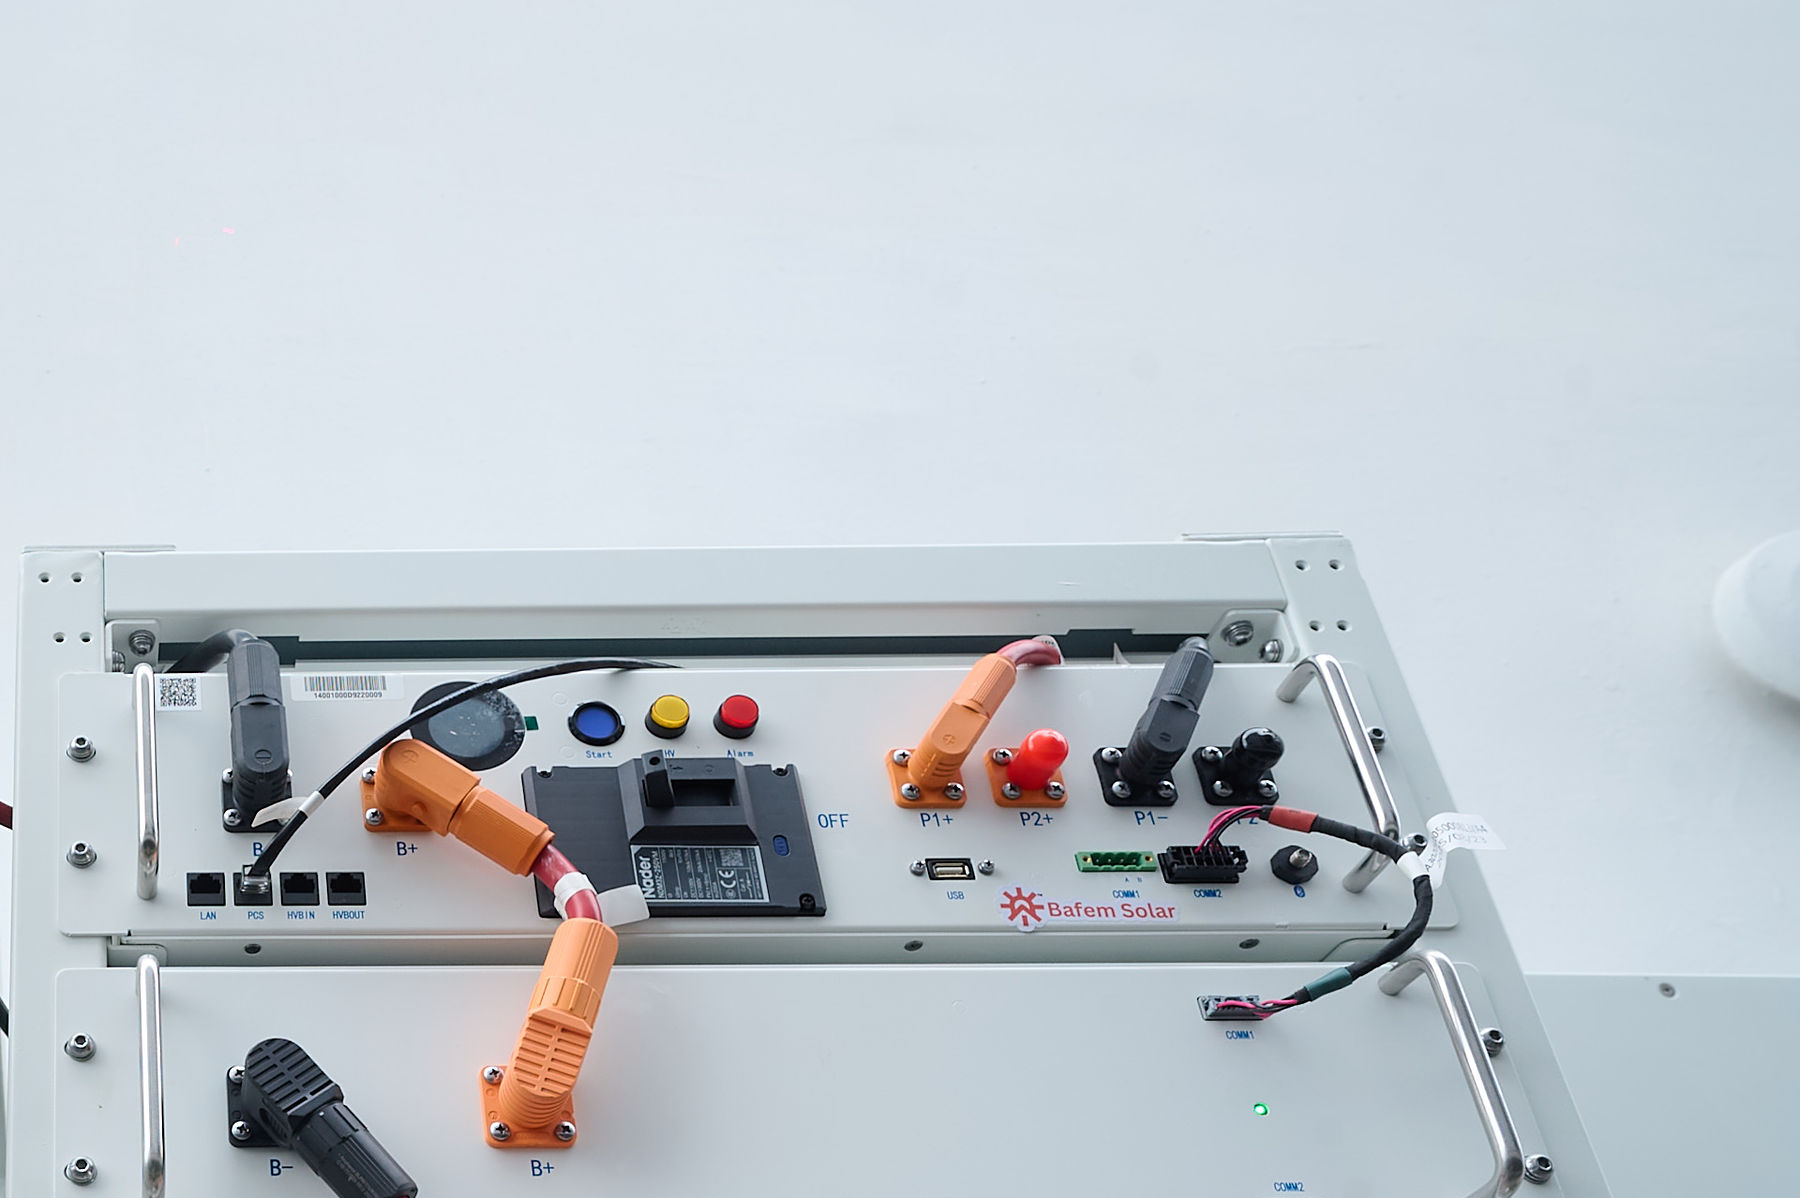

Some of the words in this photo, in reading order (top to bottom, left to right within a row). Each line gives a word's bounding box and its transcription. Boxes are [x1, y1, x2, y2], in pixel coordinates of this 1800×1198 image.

[585, 749, 612, 759] Start
[726, 749, 755, 758] Alarm
[817, 813, 850, 829] OFF
[919, 813, 954, 828] P1+
[1021, 812, 1054, 828] P2+
[1134, 810, 1169, 826] P1-
[396, 841, 419, 858] B+
[639, 855, 656, 899] Nader
[946, 889, 966, 901] USB
[1112, 889, 1140, 899] COMM1
[1194, 888, 1222, 899] COMM2
[199, 911, 217, 921] LAN
[247, 910, 265, 921] PCS
[287, 910, 316, 921] HVBIN
[331, 910, 366, 921] HVBOUT
[1048, 902, 1116, 919] Bafem
[1121, 903, 1176, 920] Solar
[1225, 1029, 1255, 1041] COMM1
[268, 1158, 294, 1177] B-
[530, 1159, 555, 1177] B+
[1273, 1181, 1305, 1194] COMM2
